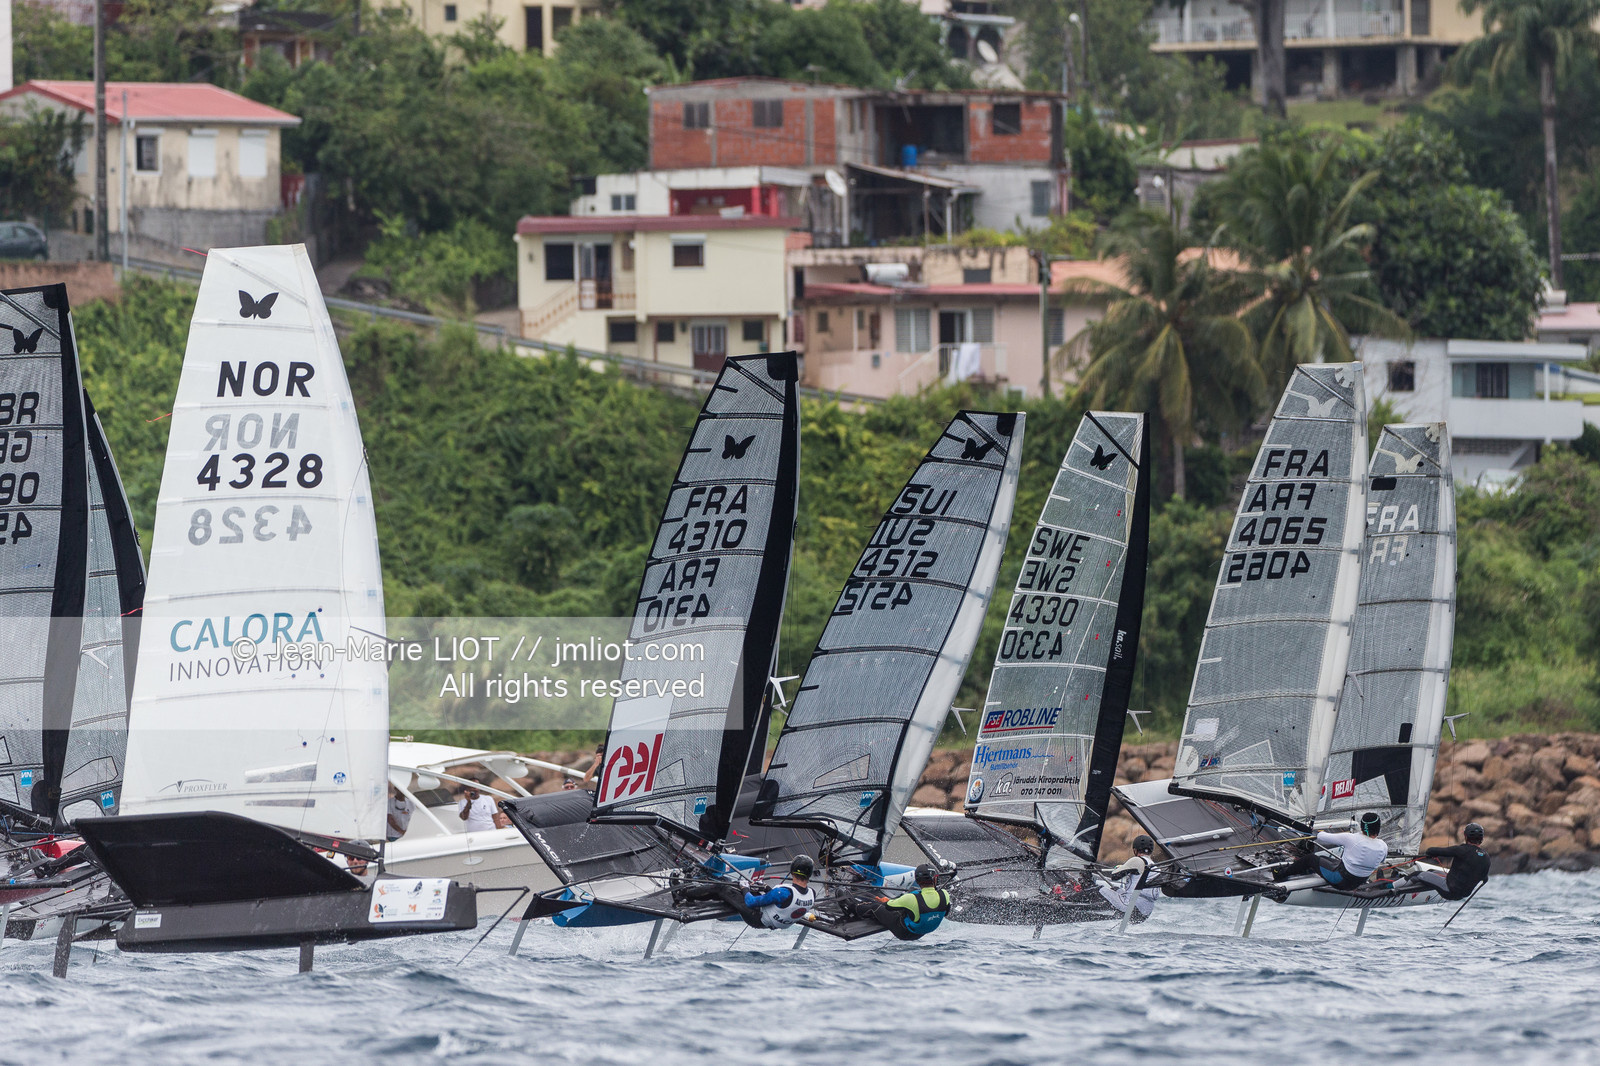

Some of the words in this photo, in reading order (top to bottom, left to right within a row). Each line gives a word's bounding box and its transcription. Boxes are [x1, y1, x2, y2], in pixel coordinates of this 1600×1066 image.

[217, 361, 315, 397] NOR
[197, 452, 323, 491] 4328
[1263, 450, 1329, 477] FRA
[684, 485, 748, 517] FRA
[894, 486, 957, 515] SUI
[1238, 516, 1327, 546] 4065
[1367, 503, 1419, 533] FRA
[668, 519, 748, 554] 4310
[1031, 527, 1090, 563] SWE
[859, 549, 939, 578] 4512
[1010, 595, 1079, 627] 4330
[170, 611, 324, 653] CALORA
[170, 653, 323, 682] INNOVATION
[1001, 708, 1062, 727] ROBLINE
[974, 746, 1032, 769] Hjertmans
[996, 780, 1012, 794] ka.
